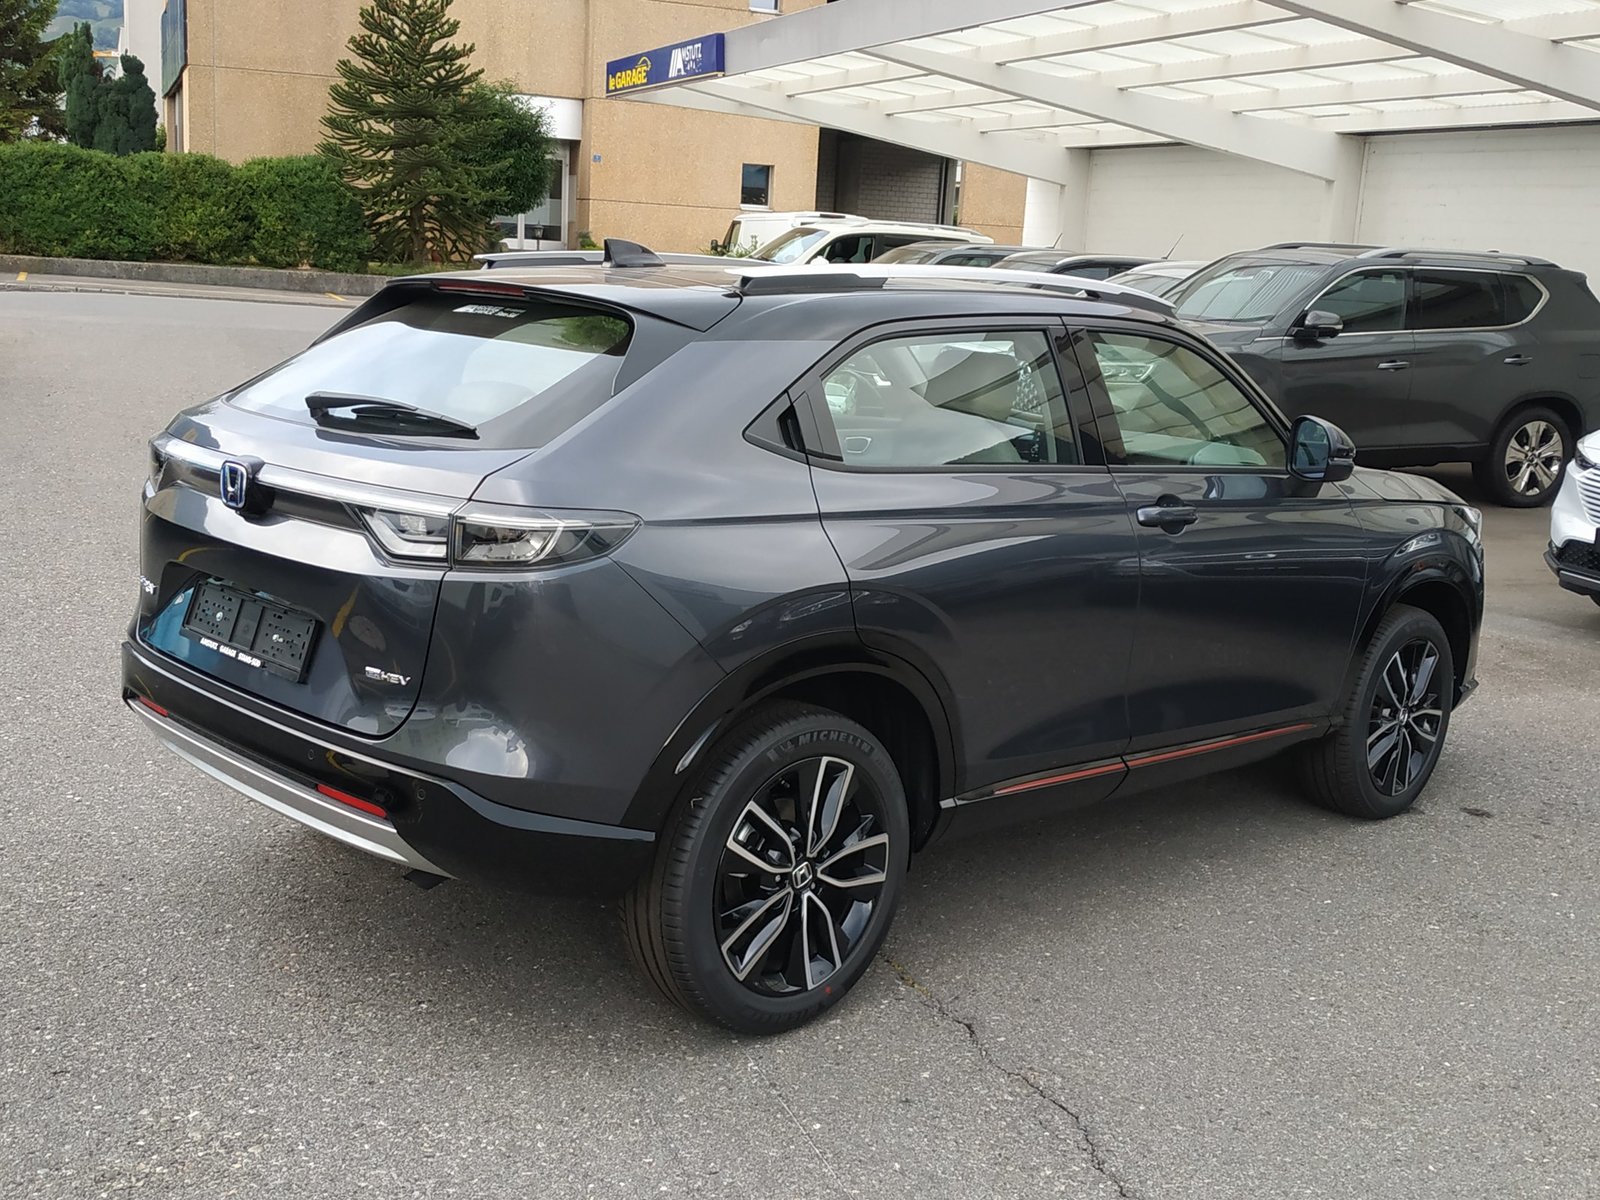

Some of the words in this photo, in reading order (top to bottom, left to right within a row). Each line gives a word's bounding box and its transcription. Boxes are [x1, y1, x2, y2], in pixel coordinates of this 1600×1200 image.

[608, 73, 616, 90] le
[615, 66, 648, 88] GARAGE
[798, 730, 873, 754] MICHELIN
